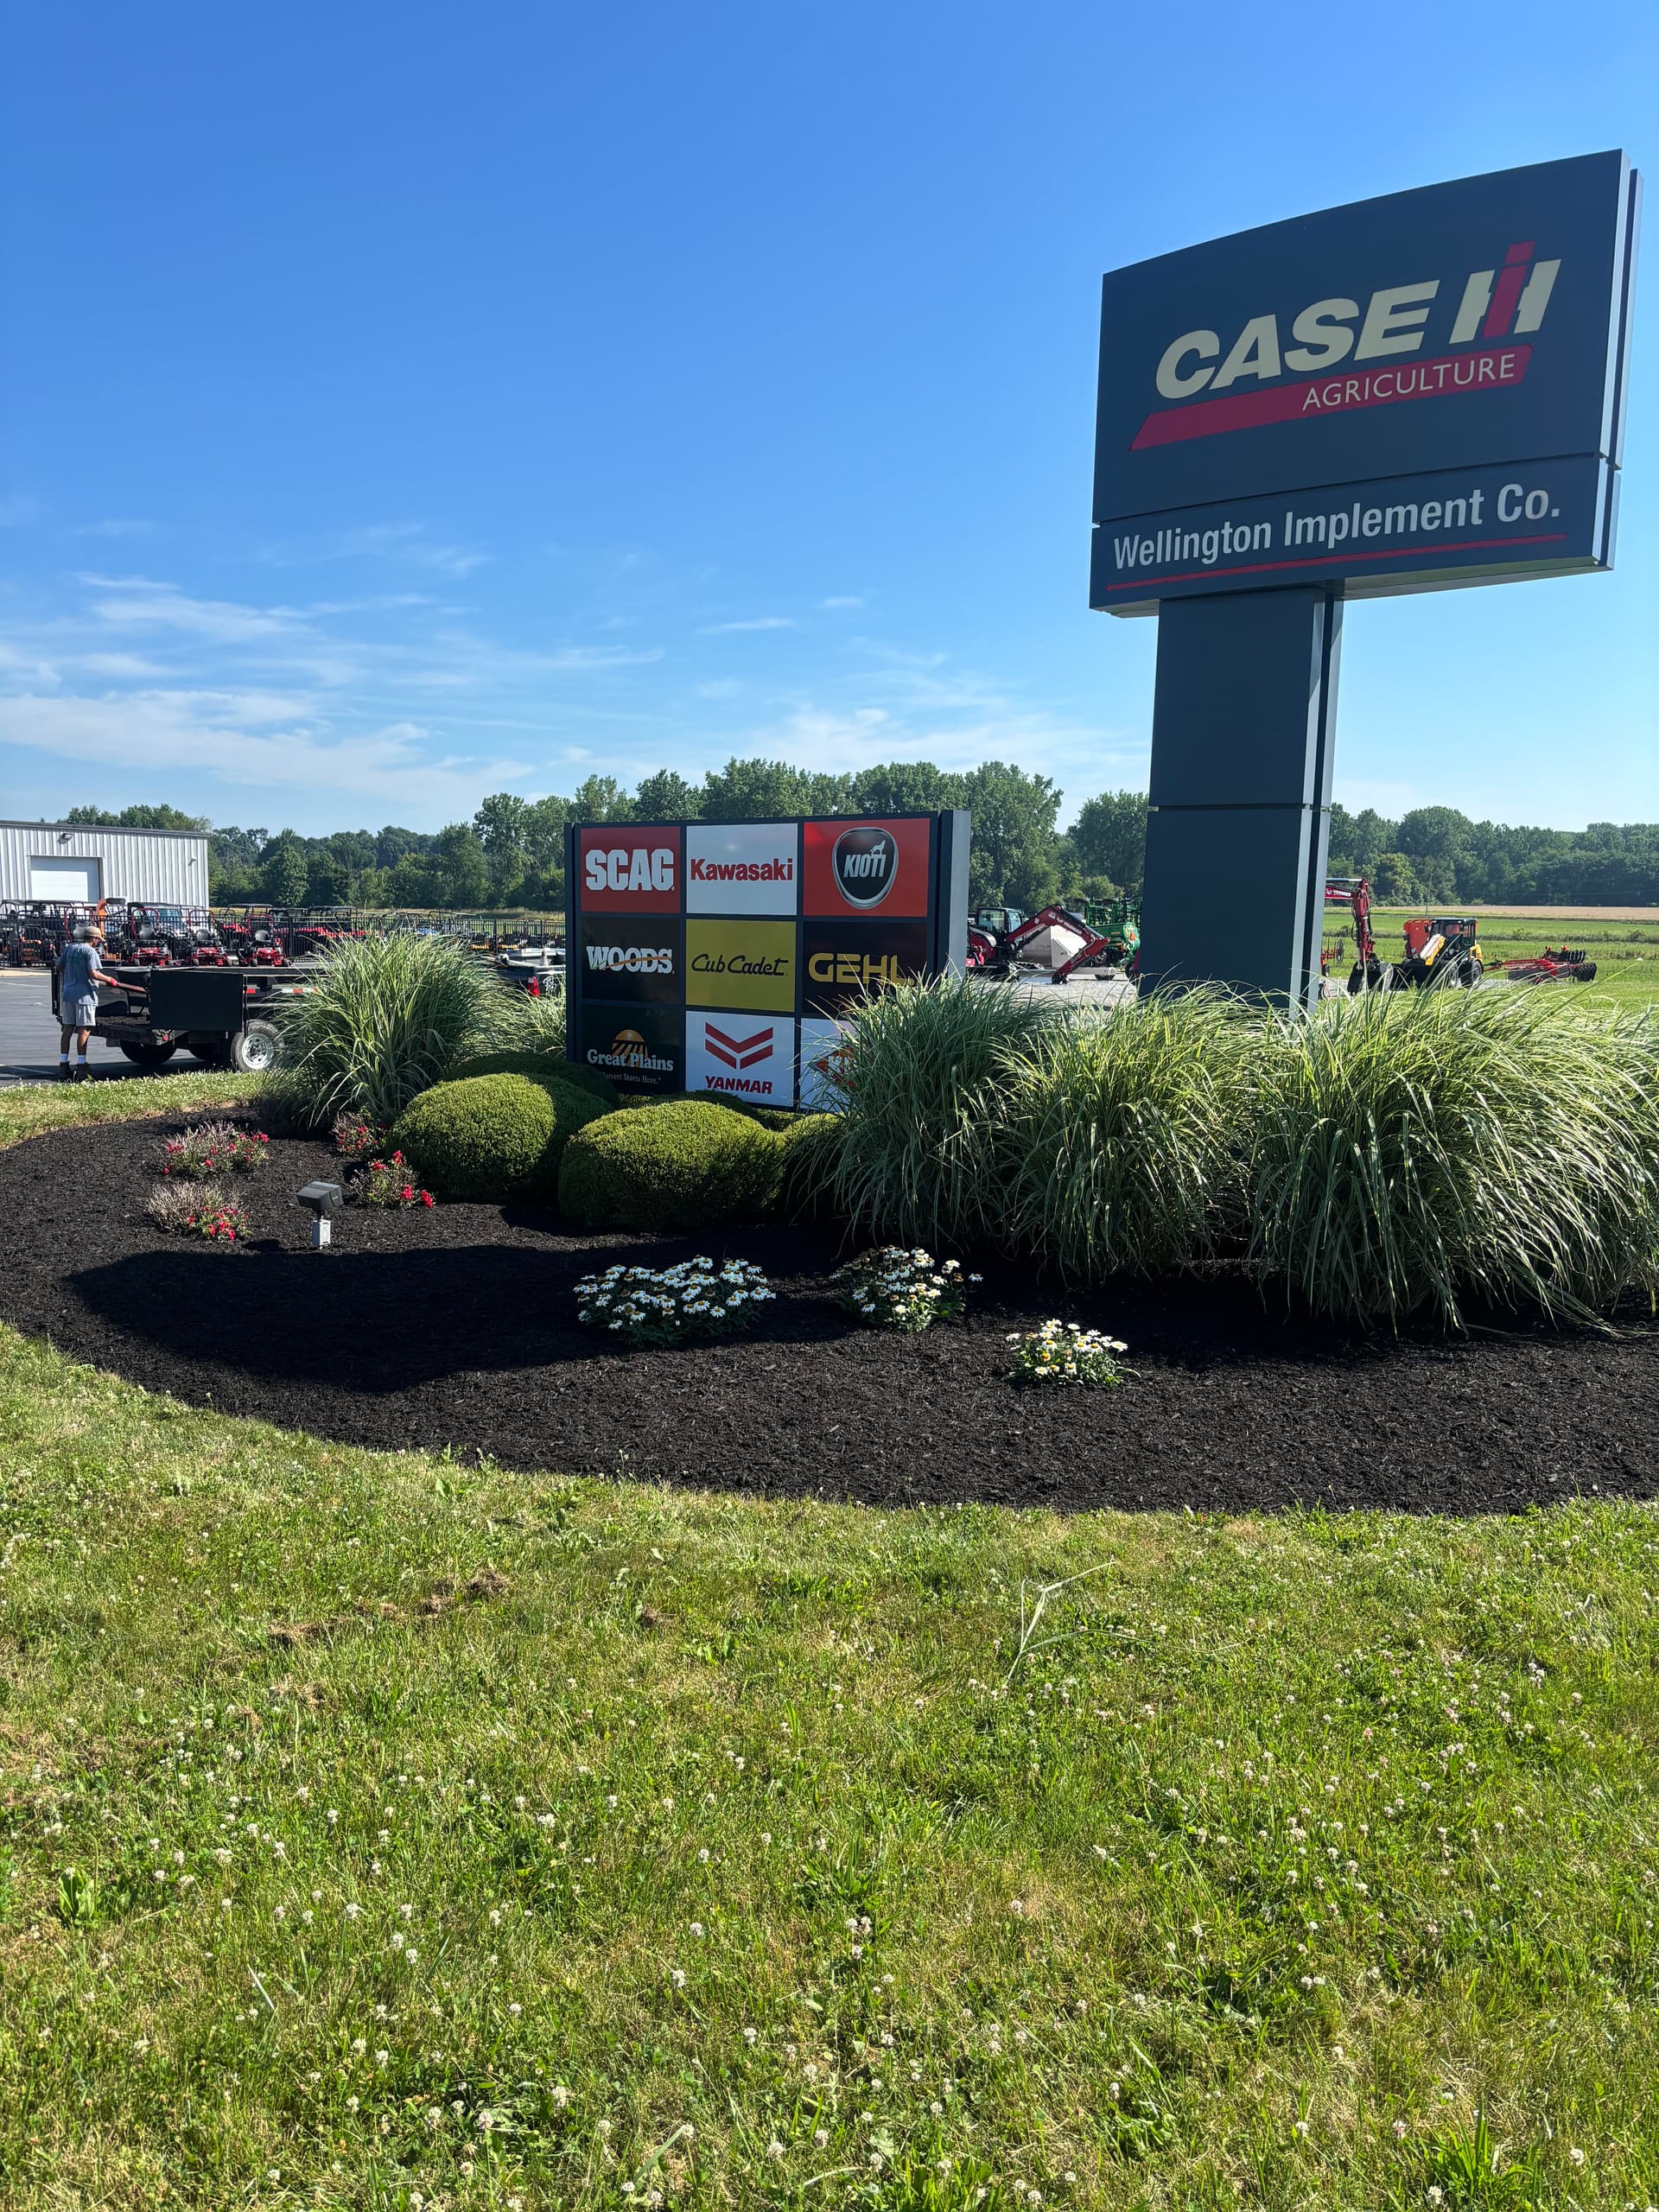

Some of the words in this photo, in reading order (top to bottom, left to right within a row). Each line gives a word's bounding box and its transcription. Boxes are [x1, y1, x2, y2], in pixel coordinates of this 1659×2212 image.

[1155, 279, 1440, 399] CASE
[1301, 353, 1516, 410] AGRICULTURE
[1114, 521, 1272, 569] Wellington
[1284, 488, 1484, 549] Implement
[1497, 483, 1560, 522] Co.
[585, 849, 674, 891] SCAG
[690, 858, 793, 881] Kawasaki
[843, 854, 887, 878] KIOTI
[586, 945, 673, 975] WOODS
[691, 953, 726, 974] Cub
[728, 955, 789, 976] Cadet
[808, 952, 915, 986] GEHL
[587, 1048, 627, 1067] Great
[628, 1052, 674, 1072] Plains
[705, 1075, 773, 1095] YANMAR
